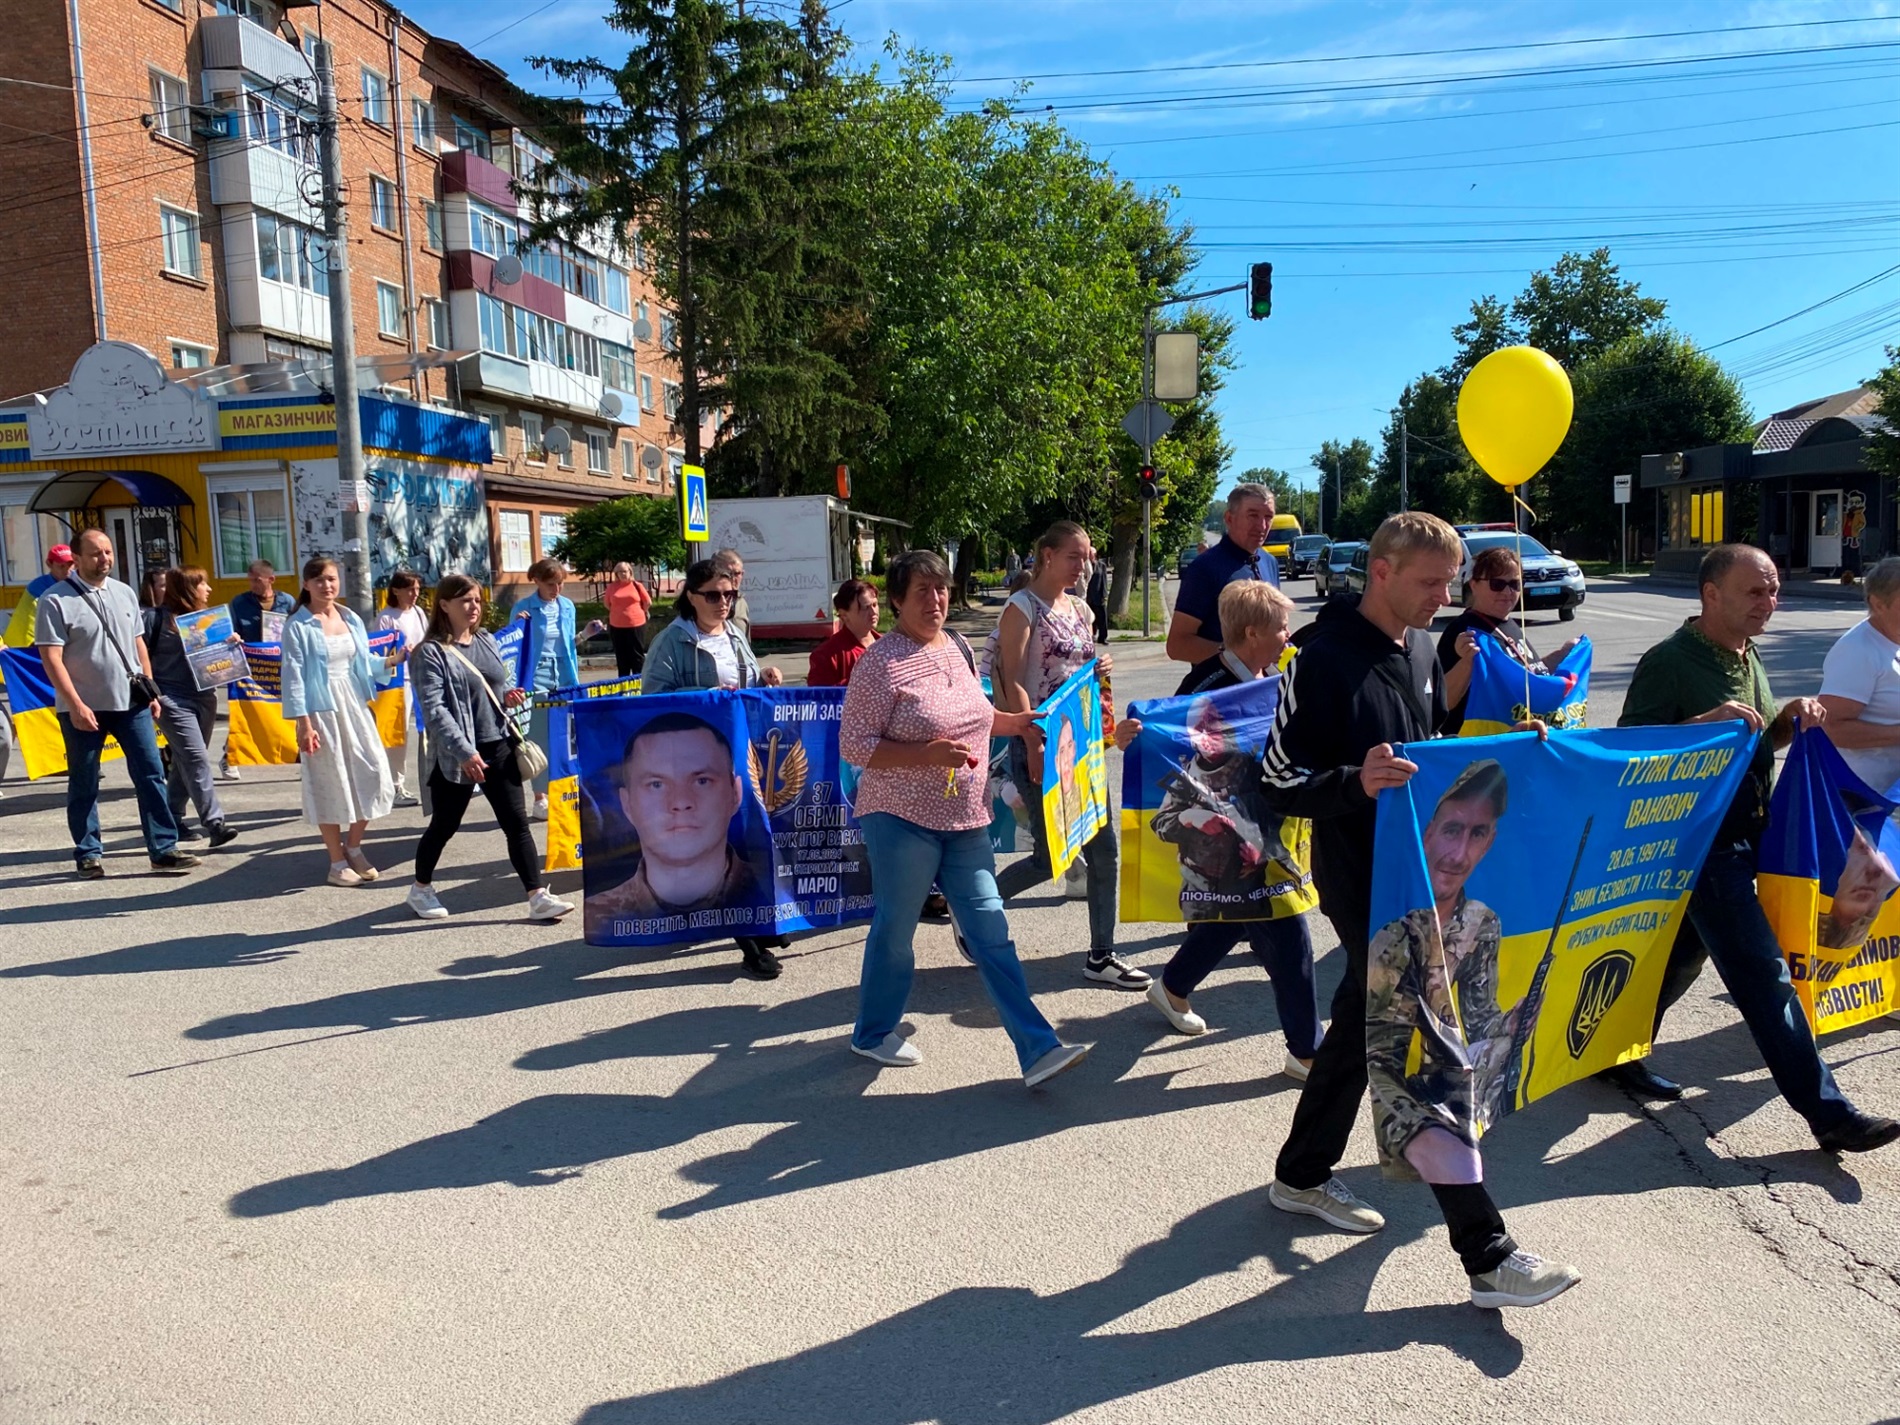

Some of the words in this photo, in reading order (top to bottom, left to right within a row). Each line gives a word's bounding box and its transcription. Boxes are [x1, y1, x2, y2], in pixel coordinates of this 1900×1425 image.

[232, 410, 336, 430] МАГАЗИНЧИК
[251, 666, 279, 675] НДРІЙ
[773, 702, 817, 722] ВІРНИЙ
[1617, 753, 1675, 788] ГУЛЯК
[1671, 747, 1735, 781] БОГДАН
[812, 781, 833, 804] 37
[794, 805, 847, 828] ОБРМП
[1624, 791, 1700, 829] ІВАНОВИЧ
[799, 831, 827, 847] ІГОР
[797, 877, 837, 895] МАРІО
[1180, 891, 1245, 904] ЛЮБИМО,
[1570, 886, 1599, 912] ЗНИК
[1597, 874, 1642, 905] БЕЗВІСТИ
[613, 914, 687, 937] ПОВЕРНІТЬ
[689, 909, 721, 929] МЕНІ
[722, 907, 753, 926] МОЄ
[1611, 911, 1659, 936] БРИГАДА
